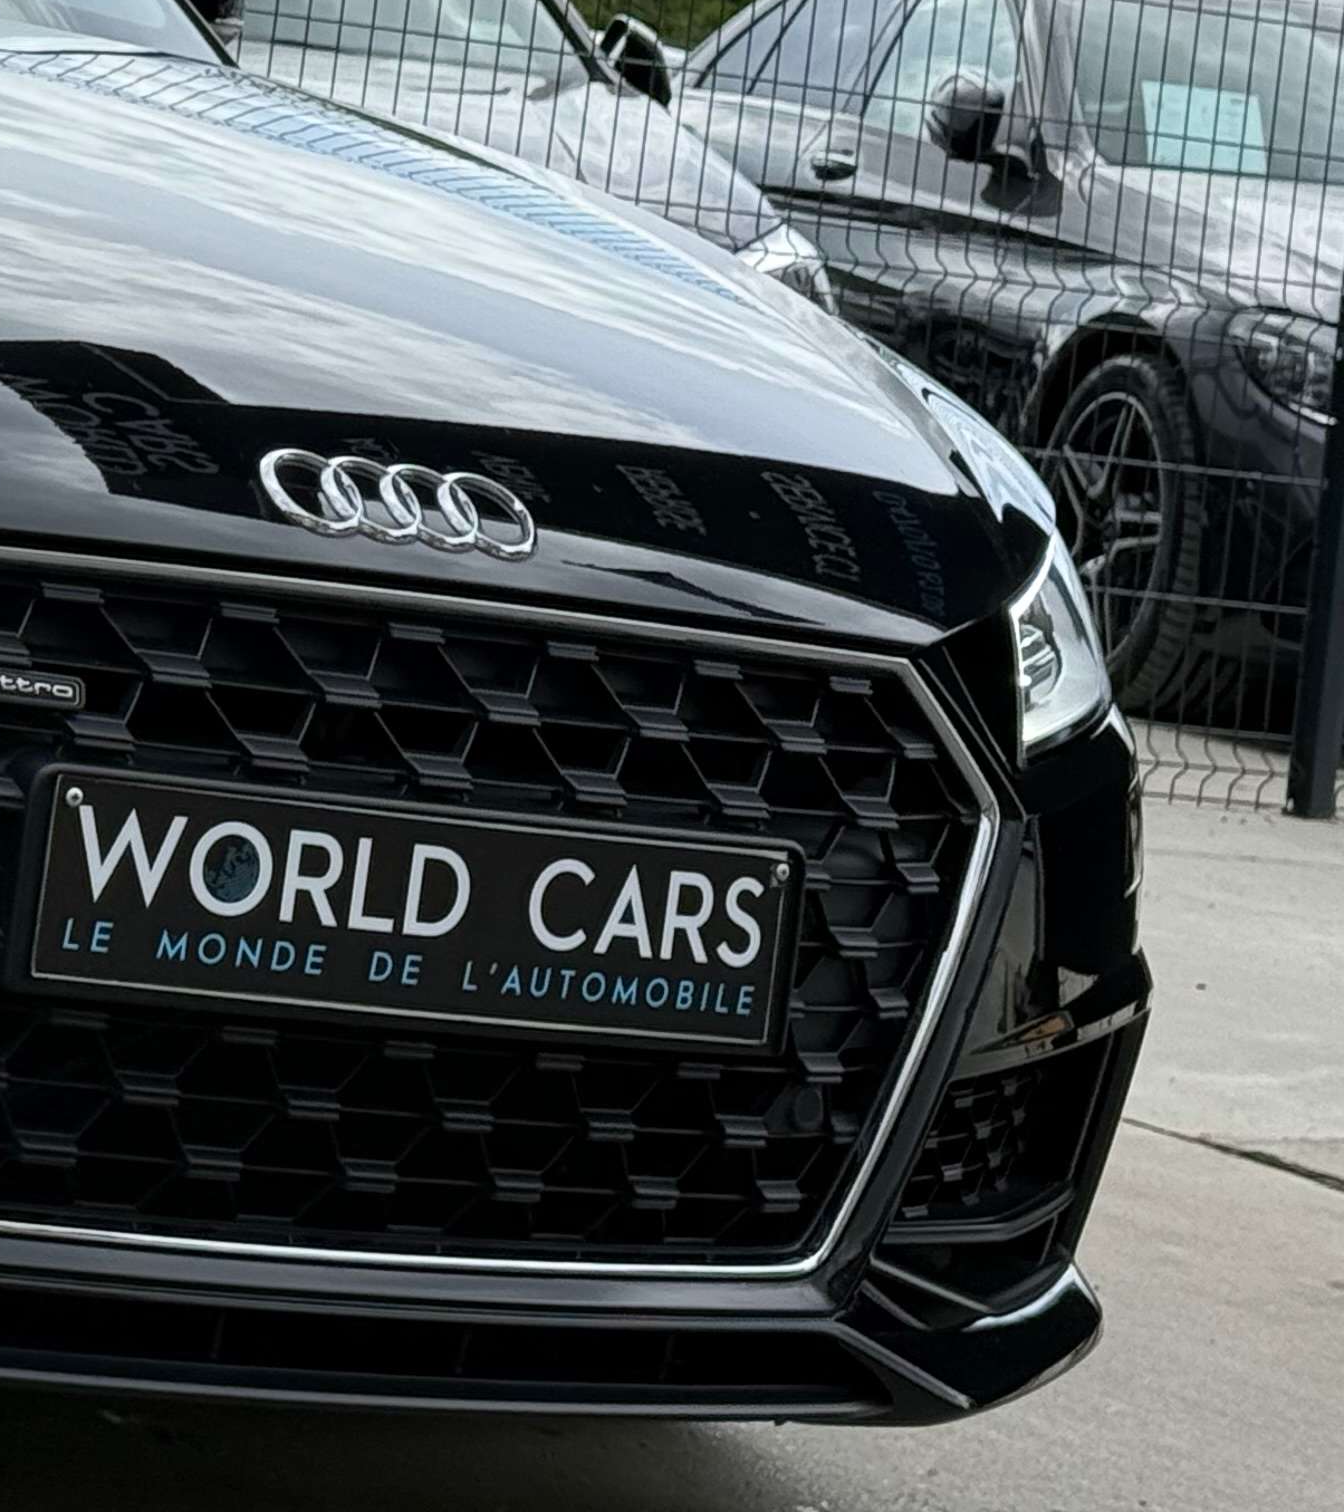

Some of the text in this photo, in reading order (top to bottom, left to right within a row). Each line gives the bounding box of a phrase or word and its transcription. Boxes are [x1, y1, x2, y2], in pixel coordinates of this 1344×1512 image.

[77, 804, 766, 969] WORLD CARS
[61, 917, 755, 1016] LE MONDE DE L'AUTOMOBILE
